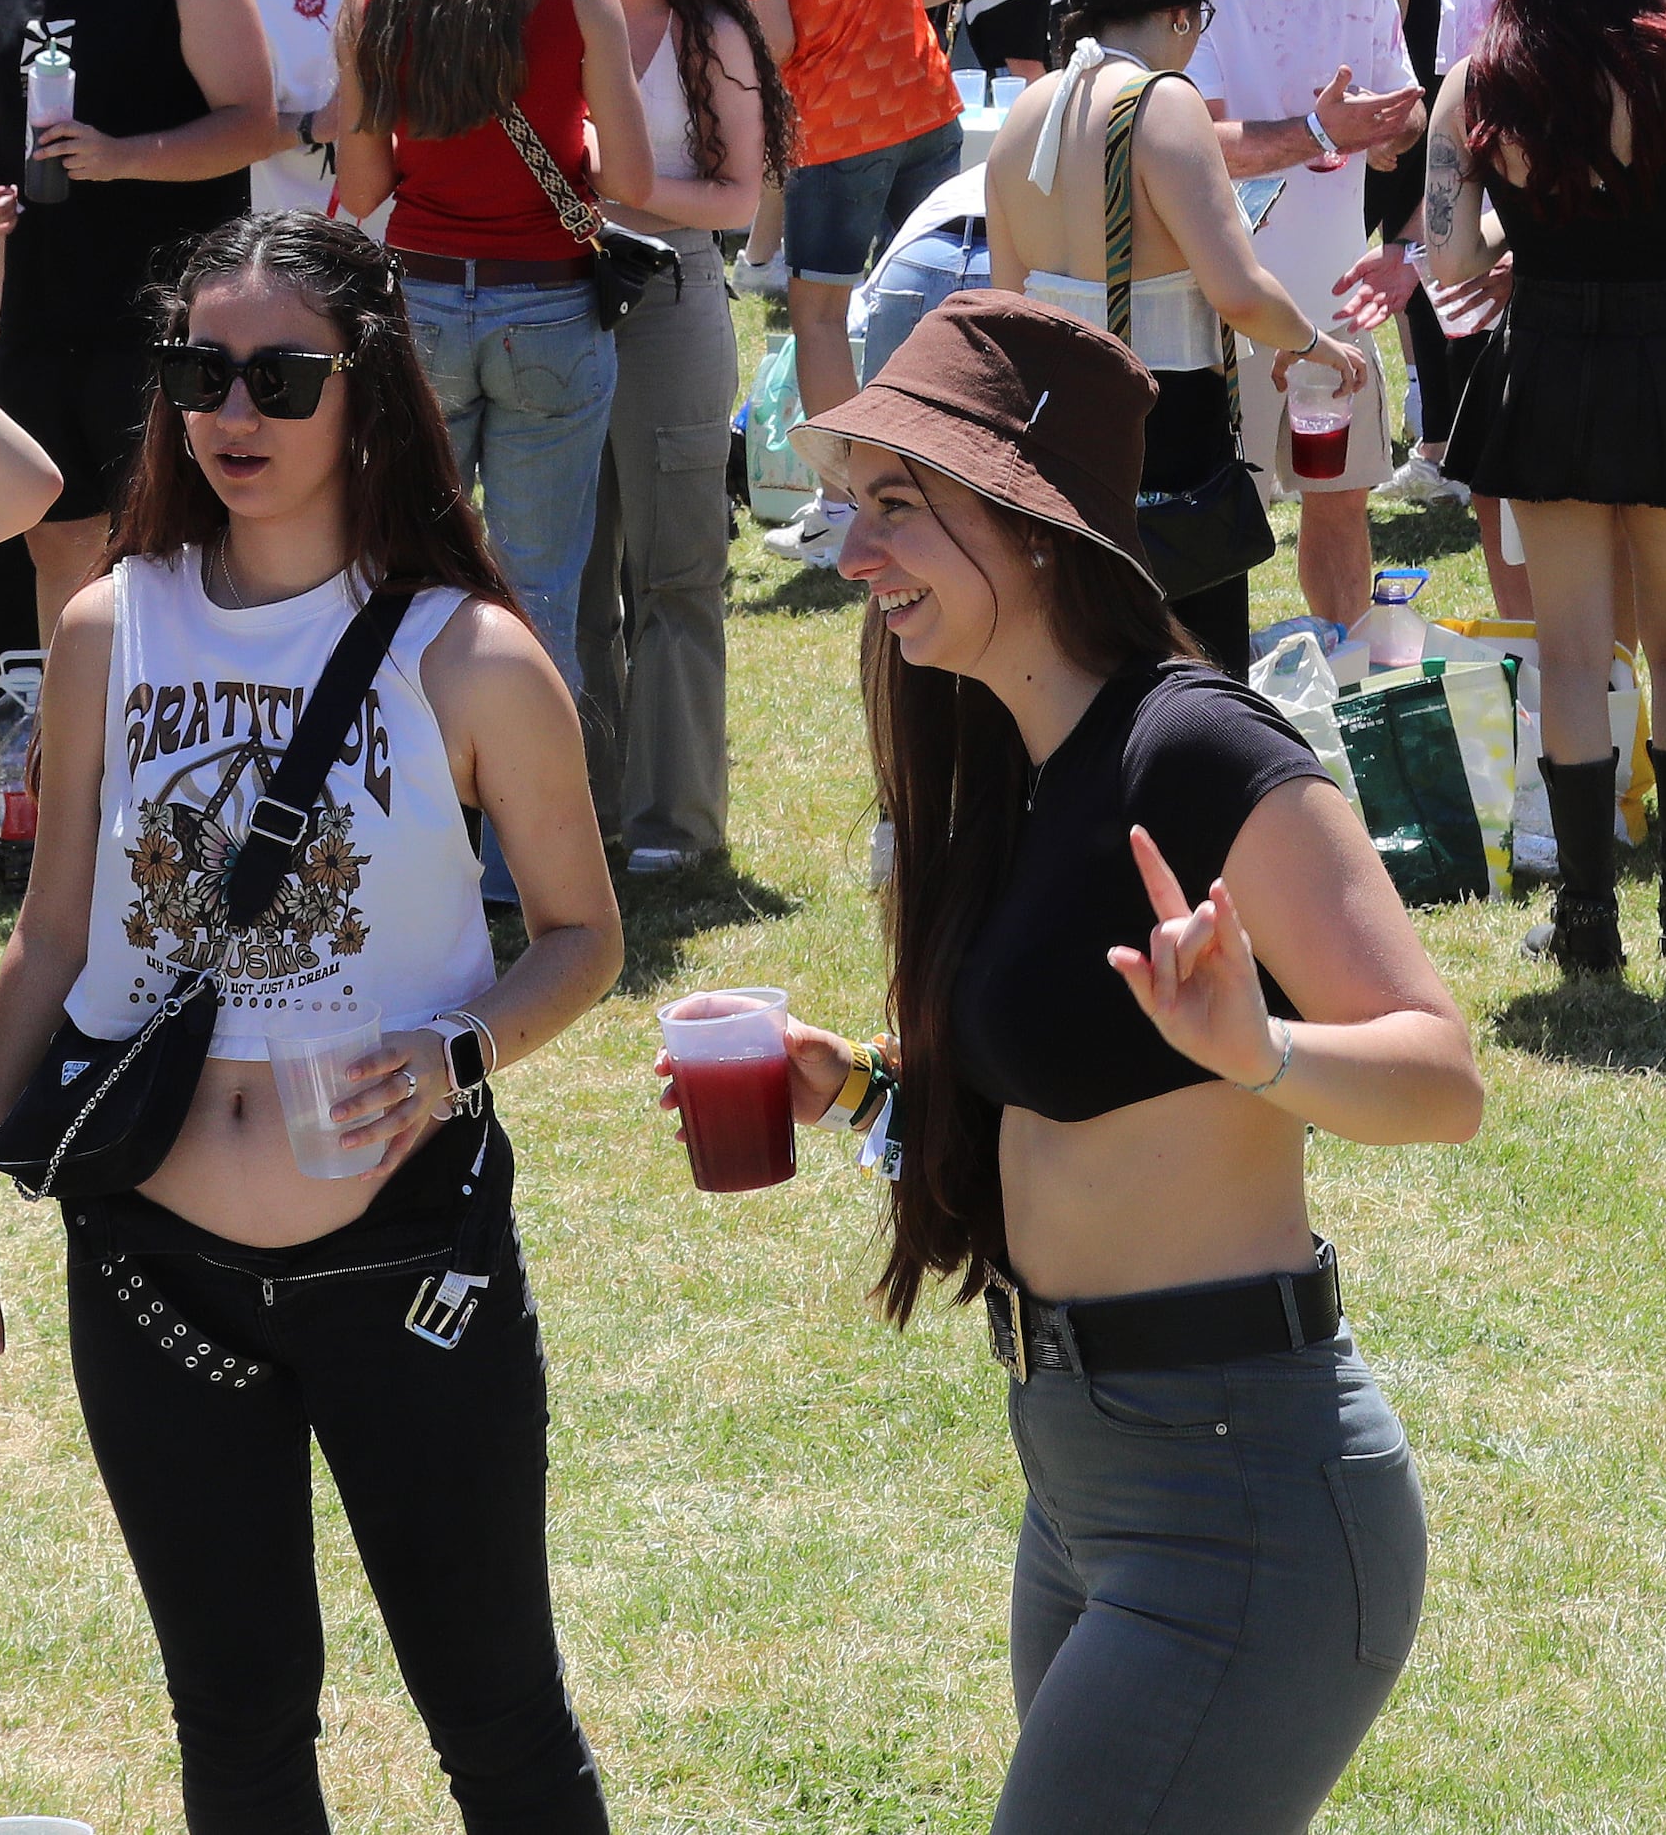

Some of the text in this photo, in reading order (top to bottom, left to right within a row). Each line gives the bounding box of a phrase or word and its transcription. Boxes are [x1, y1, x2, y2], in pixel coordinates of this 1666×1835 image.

[123, 681, 390, 818] GRATITDE
[257, 980, 284, 996] JUST
[286, 977, 294, 990] A
[297, 961, 341, 988] DREAM
